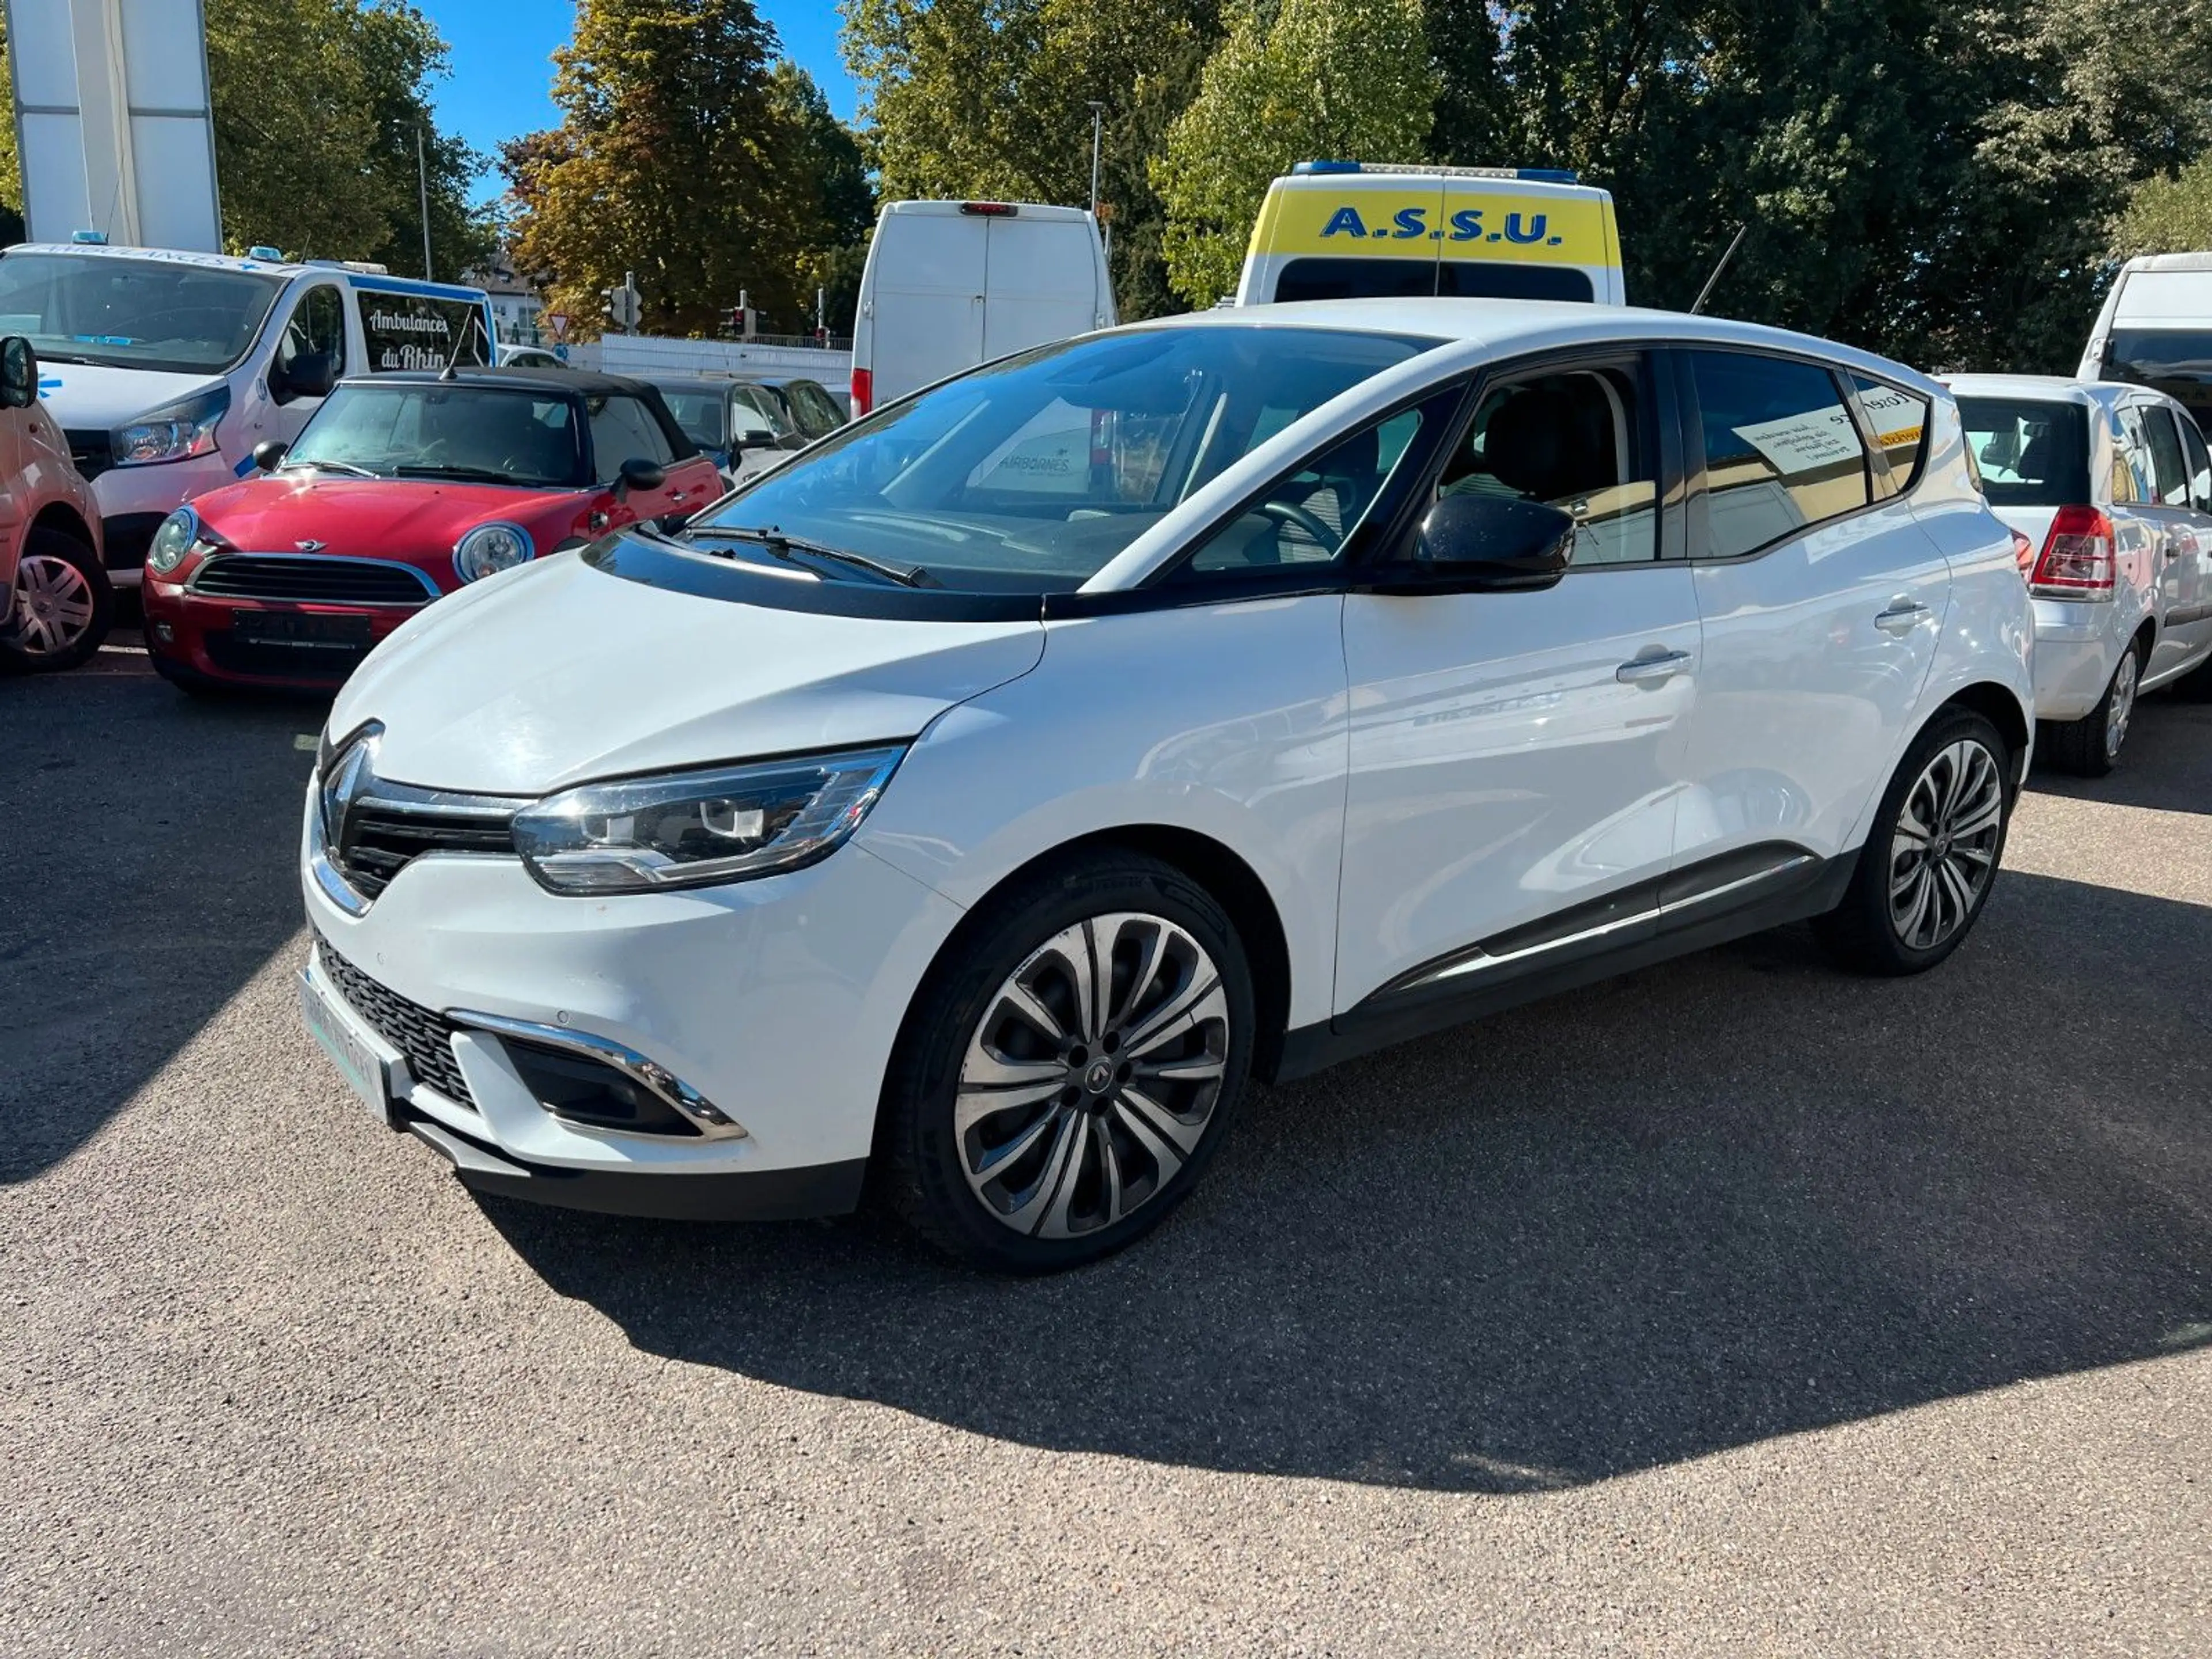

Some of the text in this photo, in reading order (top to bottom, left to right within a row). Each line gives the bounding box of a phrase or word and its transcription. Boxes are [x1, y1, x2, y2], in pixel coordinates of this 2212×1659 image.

[1319, 207, 1563, 245] A.S.S.U.
[369, 309, 449, 333] Ambulances
[381, 344, 446, 370] du Rhin
